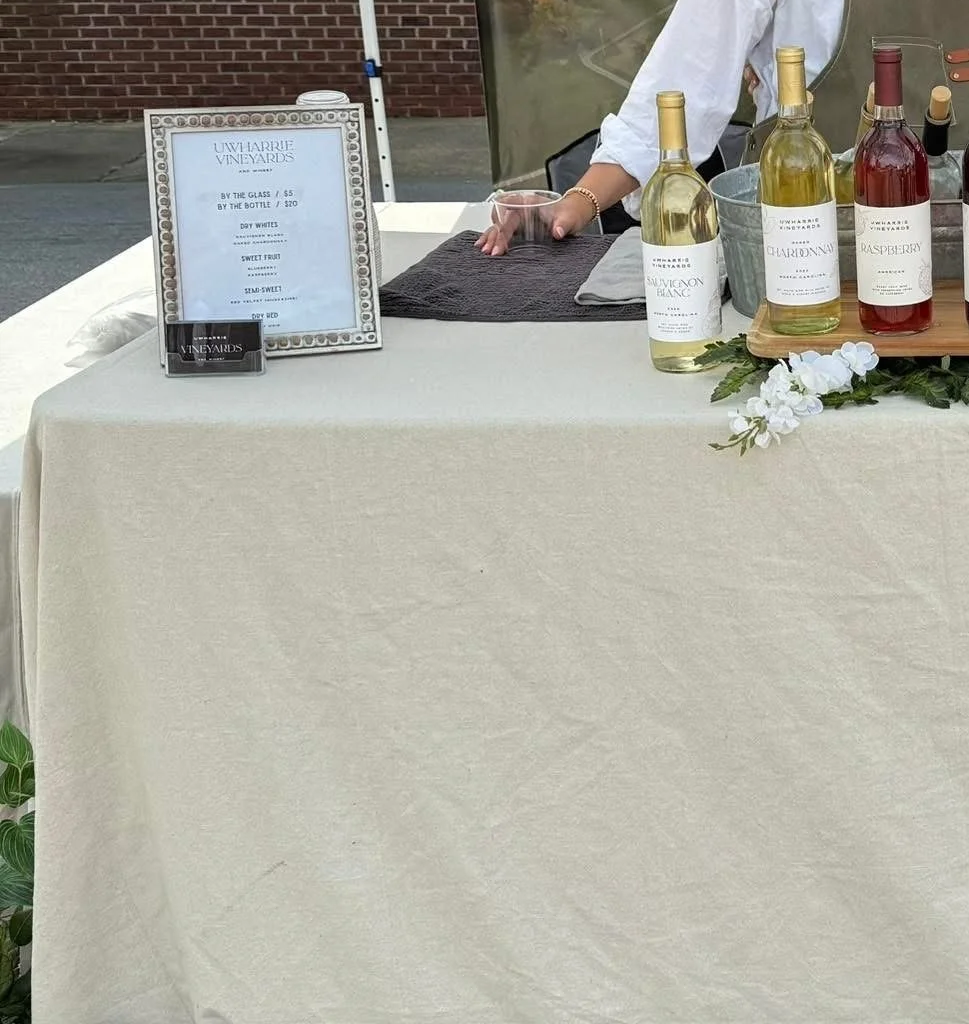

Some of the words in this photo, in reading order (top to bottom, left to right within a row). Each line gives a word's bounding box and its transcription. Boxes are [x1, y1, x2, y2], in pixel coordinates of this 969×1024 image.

[214, 140, 294, 153] UWHARRIE
[216, 153, 295, 165] VINEYARDS
[248, 191, 271, 199] GLASS
[284, 189, 294, 197] $5
[244, 201, 271, 209] BOTTLE
[284, 200, 298, 208] $20
[255, 221, 279, 229] WHITES
[766, 243, 834, 258] CHARDONNAY
[860, 242, 922, 256] RASPBERRY
[241, 254, 262, 262] SWEET
[263, 253, 281, 261] FRUIT
[647, 277, 704, 288] SAUVIGNON
[244, 285, 282, 294] SEMI-SWEET
[656, 288, 691, 298] BLANC
[180, 343, 243, 354] VINEYARDS
